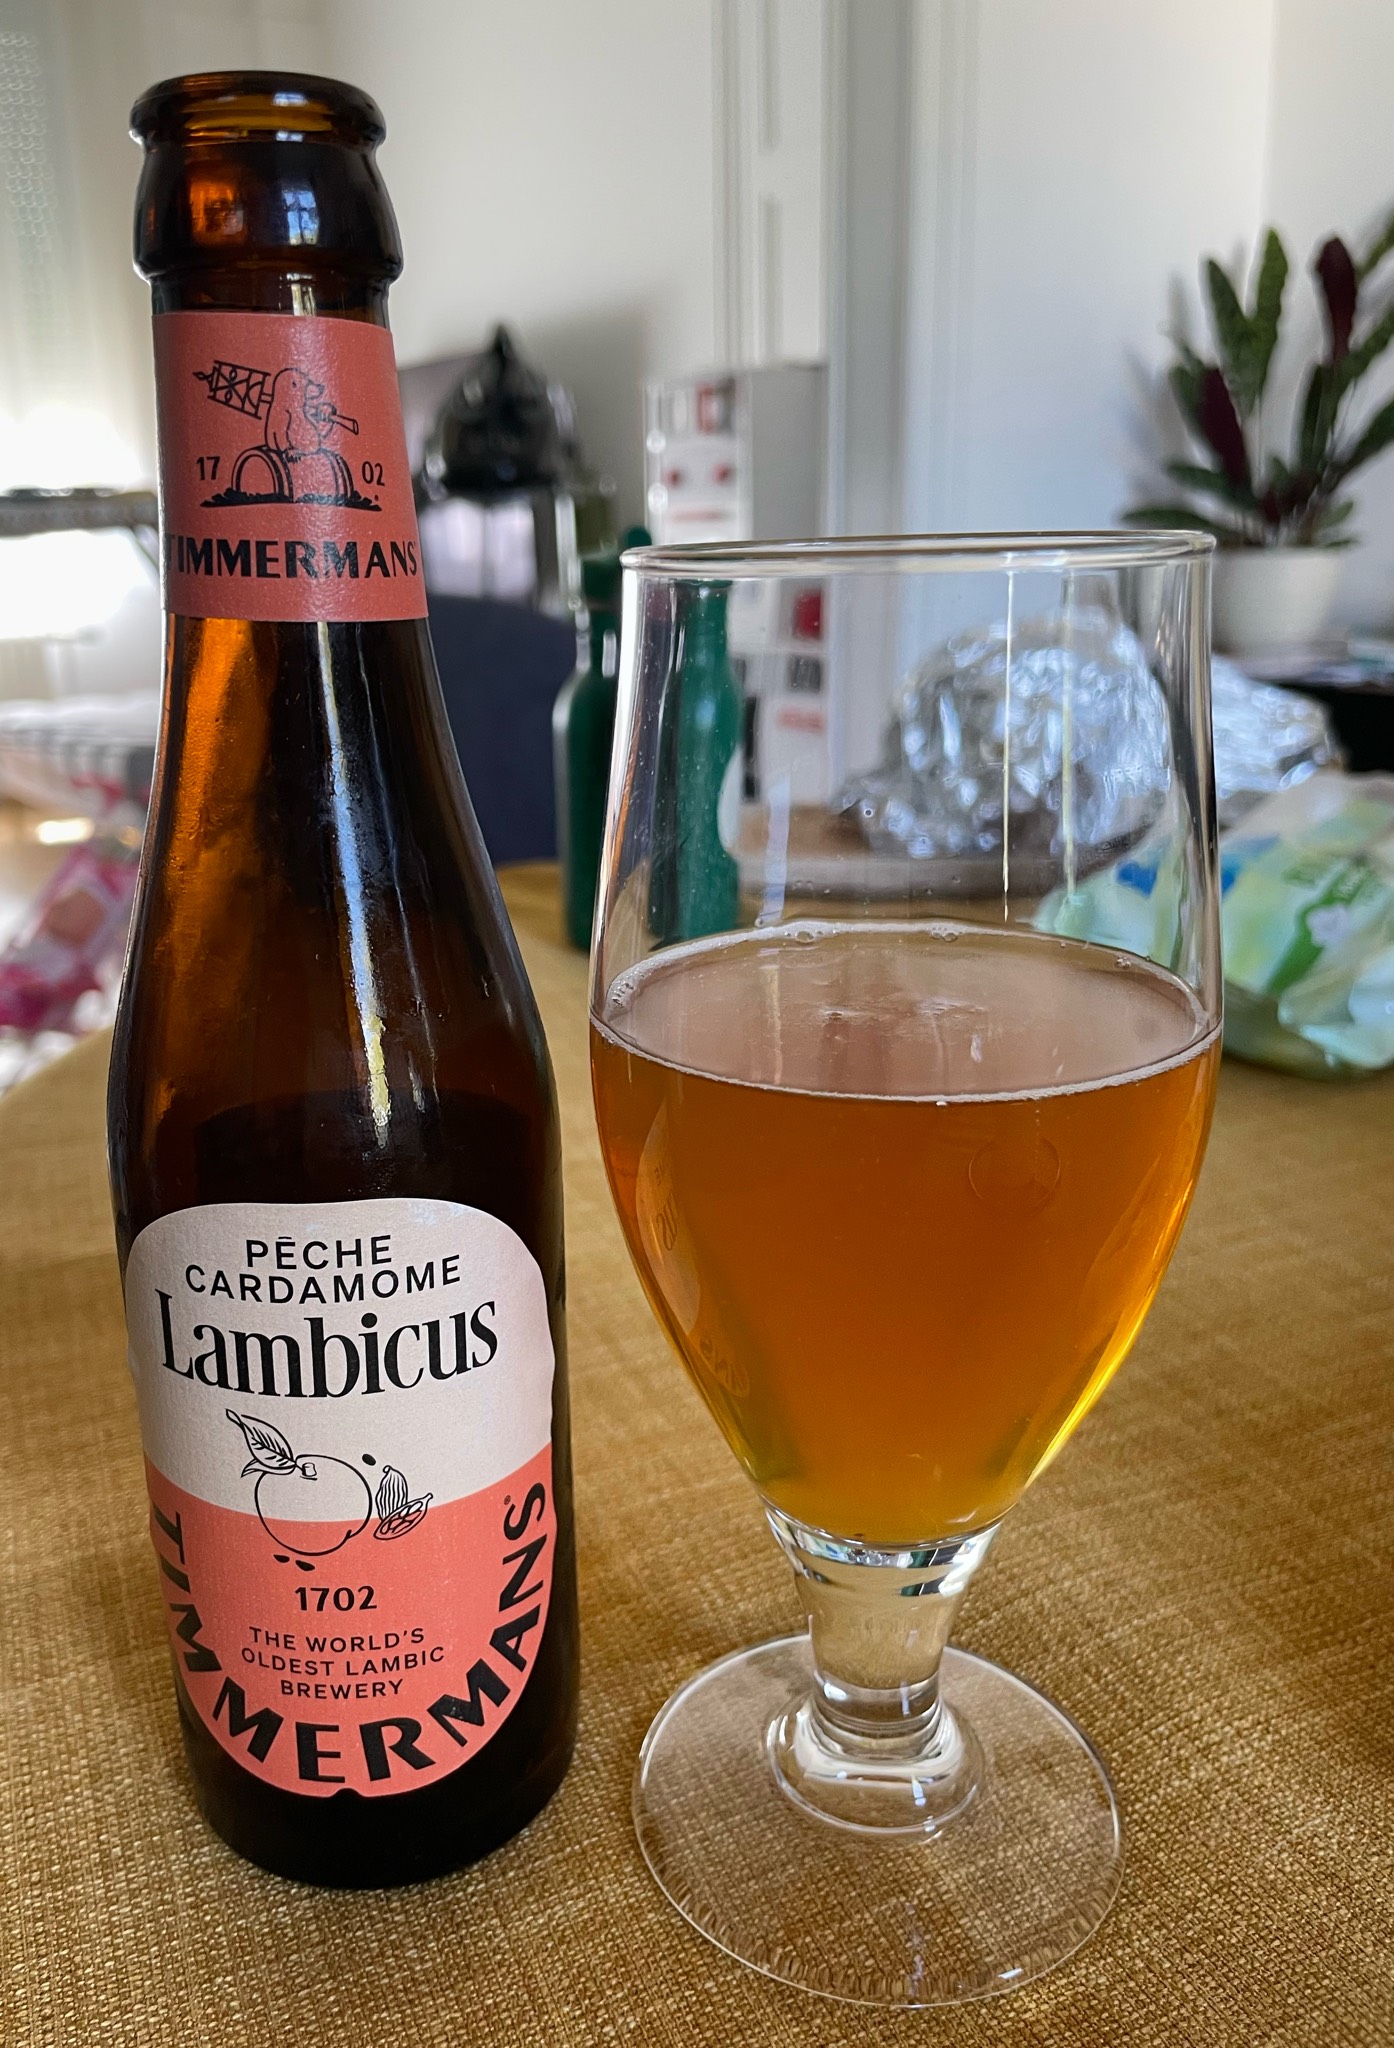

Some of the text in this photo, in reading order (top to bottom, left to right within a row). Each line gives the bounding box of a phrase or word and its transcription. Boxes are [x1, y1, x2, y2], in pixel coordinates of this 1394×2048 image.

[196, 456, 385, 486] 17 02
[185, 1254, 461, 1305] CARDAMOME
[154, 1288, 498, 1398] Lambicus
[294, 1585, 378, 1612] 1702
[249, 1626, 425, 1653] THE WORLD'S
[241, 1646, 445, 1676] OLDEST LAMBIC
[280, 1678, 403, 1700] BREWERY
